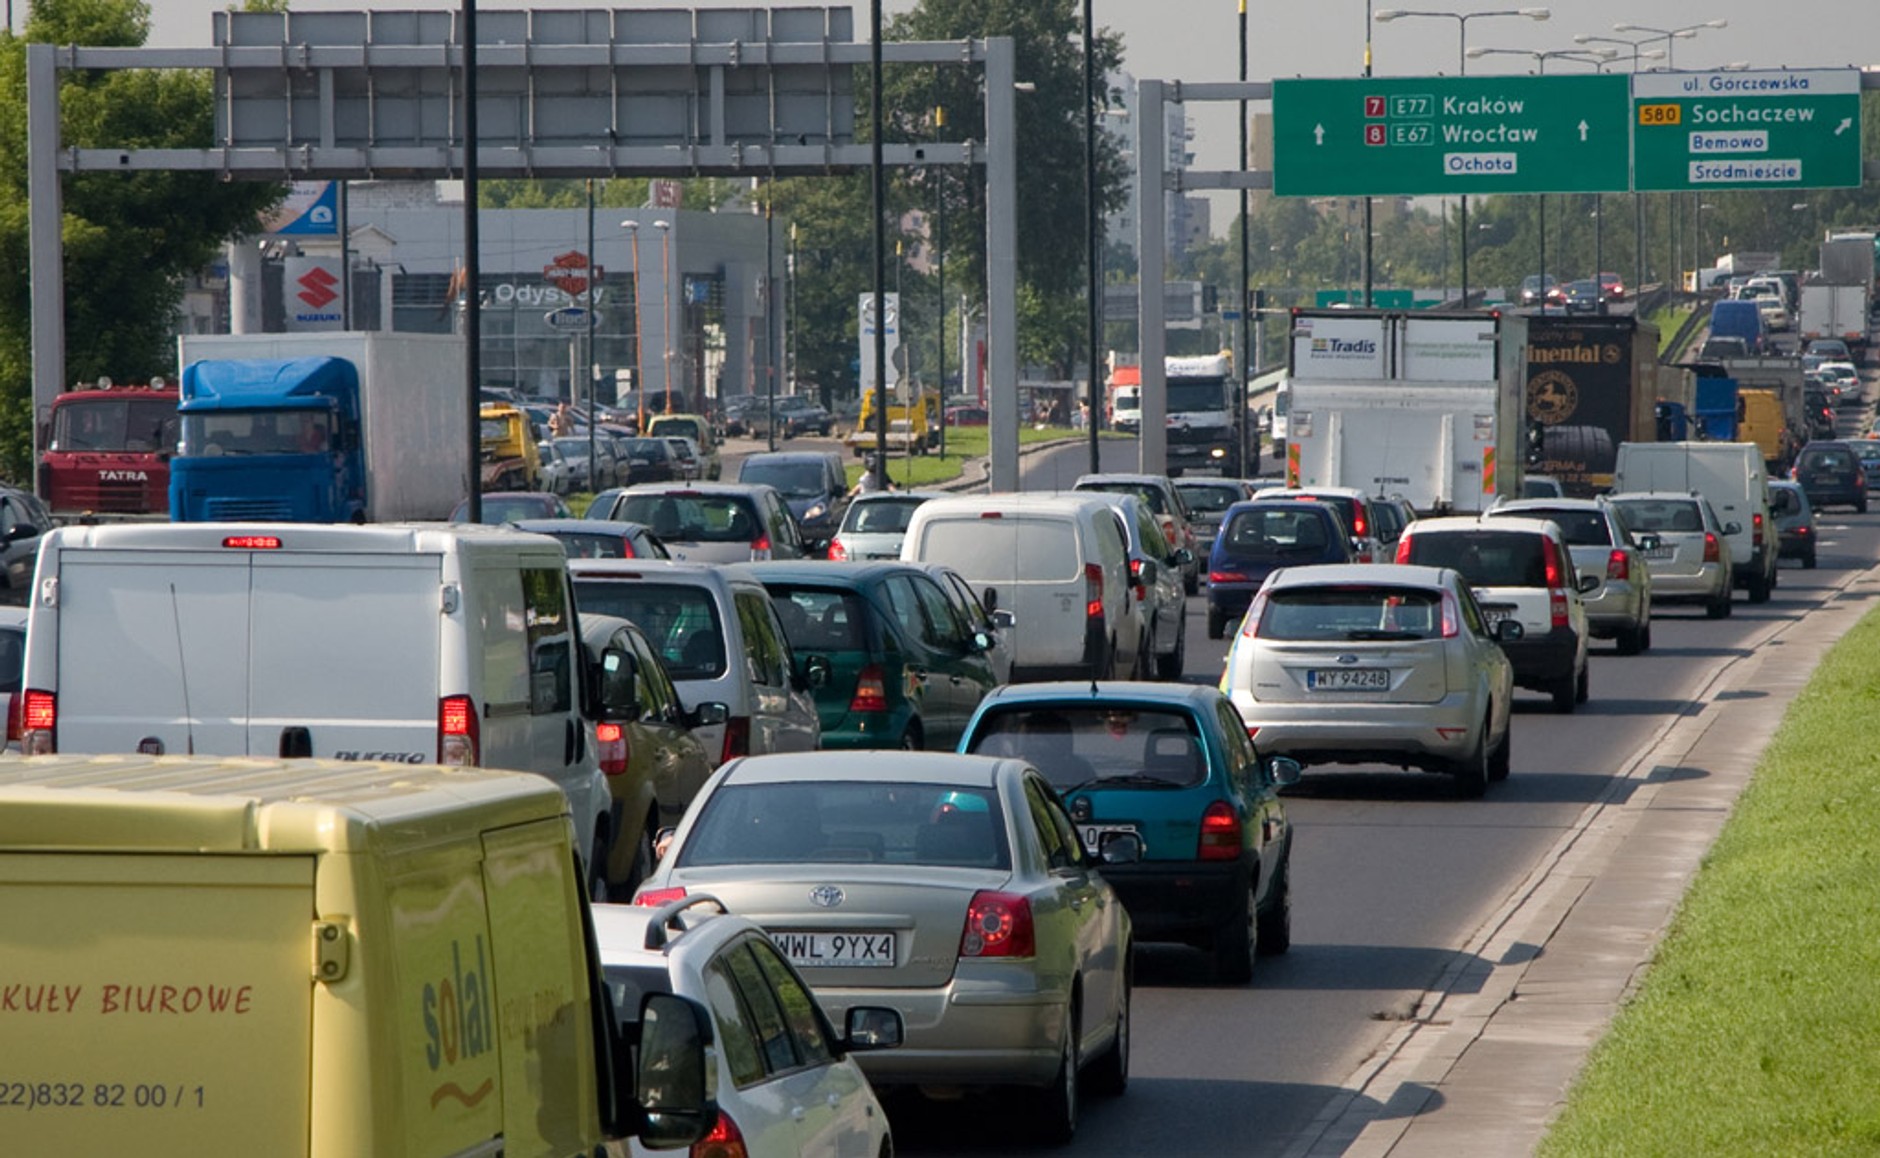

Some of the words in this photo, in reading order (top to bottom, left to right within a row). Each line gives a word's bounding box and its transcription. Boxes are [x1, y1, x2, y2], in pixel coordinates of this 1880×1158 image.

[1683, 77, 1703, 92] ul.
[1370, 99, 1380, 113] 7
[1397, 99, 1427, 114] E77
[1443, 95, 1524, 115] Kraków
[1644, 107, 1676, 122] 580
[1692, 103, 1816, 123] Sochaczew
[1370, 127, 1381, 142] 8
[1396, 126, 1428, 143] E67
[1442, 124, 1538, 143] Wrocław
[1692, 135, 1764, 150] Bemowo
[1449, 156, 1513, 171] Ochota
[1329, 338, 1376, 354] Tradis
[98, 470, 148, 481] TATRA
[1318, 670, 1336, 686] WY
[1341, 669, 1386, 686] 94248
[774, 935, 823, 958] WWL
[832, 935, 891, 959] 9YX4
[1, 983, 82, 1013] KUŁY
[101, 983, 253, 1015] BIUROWE
[422, 933, 493, 1072] solal
[93, 1083, 126, 1107] 82
[134, 1084, 167, 1108] 00
[194, 1085, 205, 1108] 1
